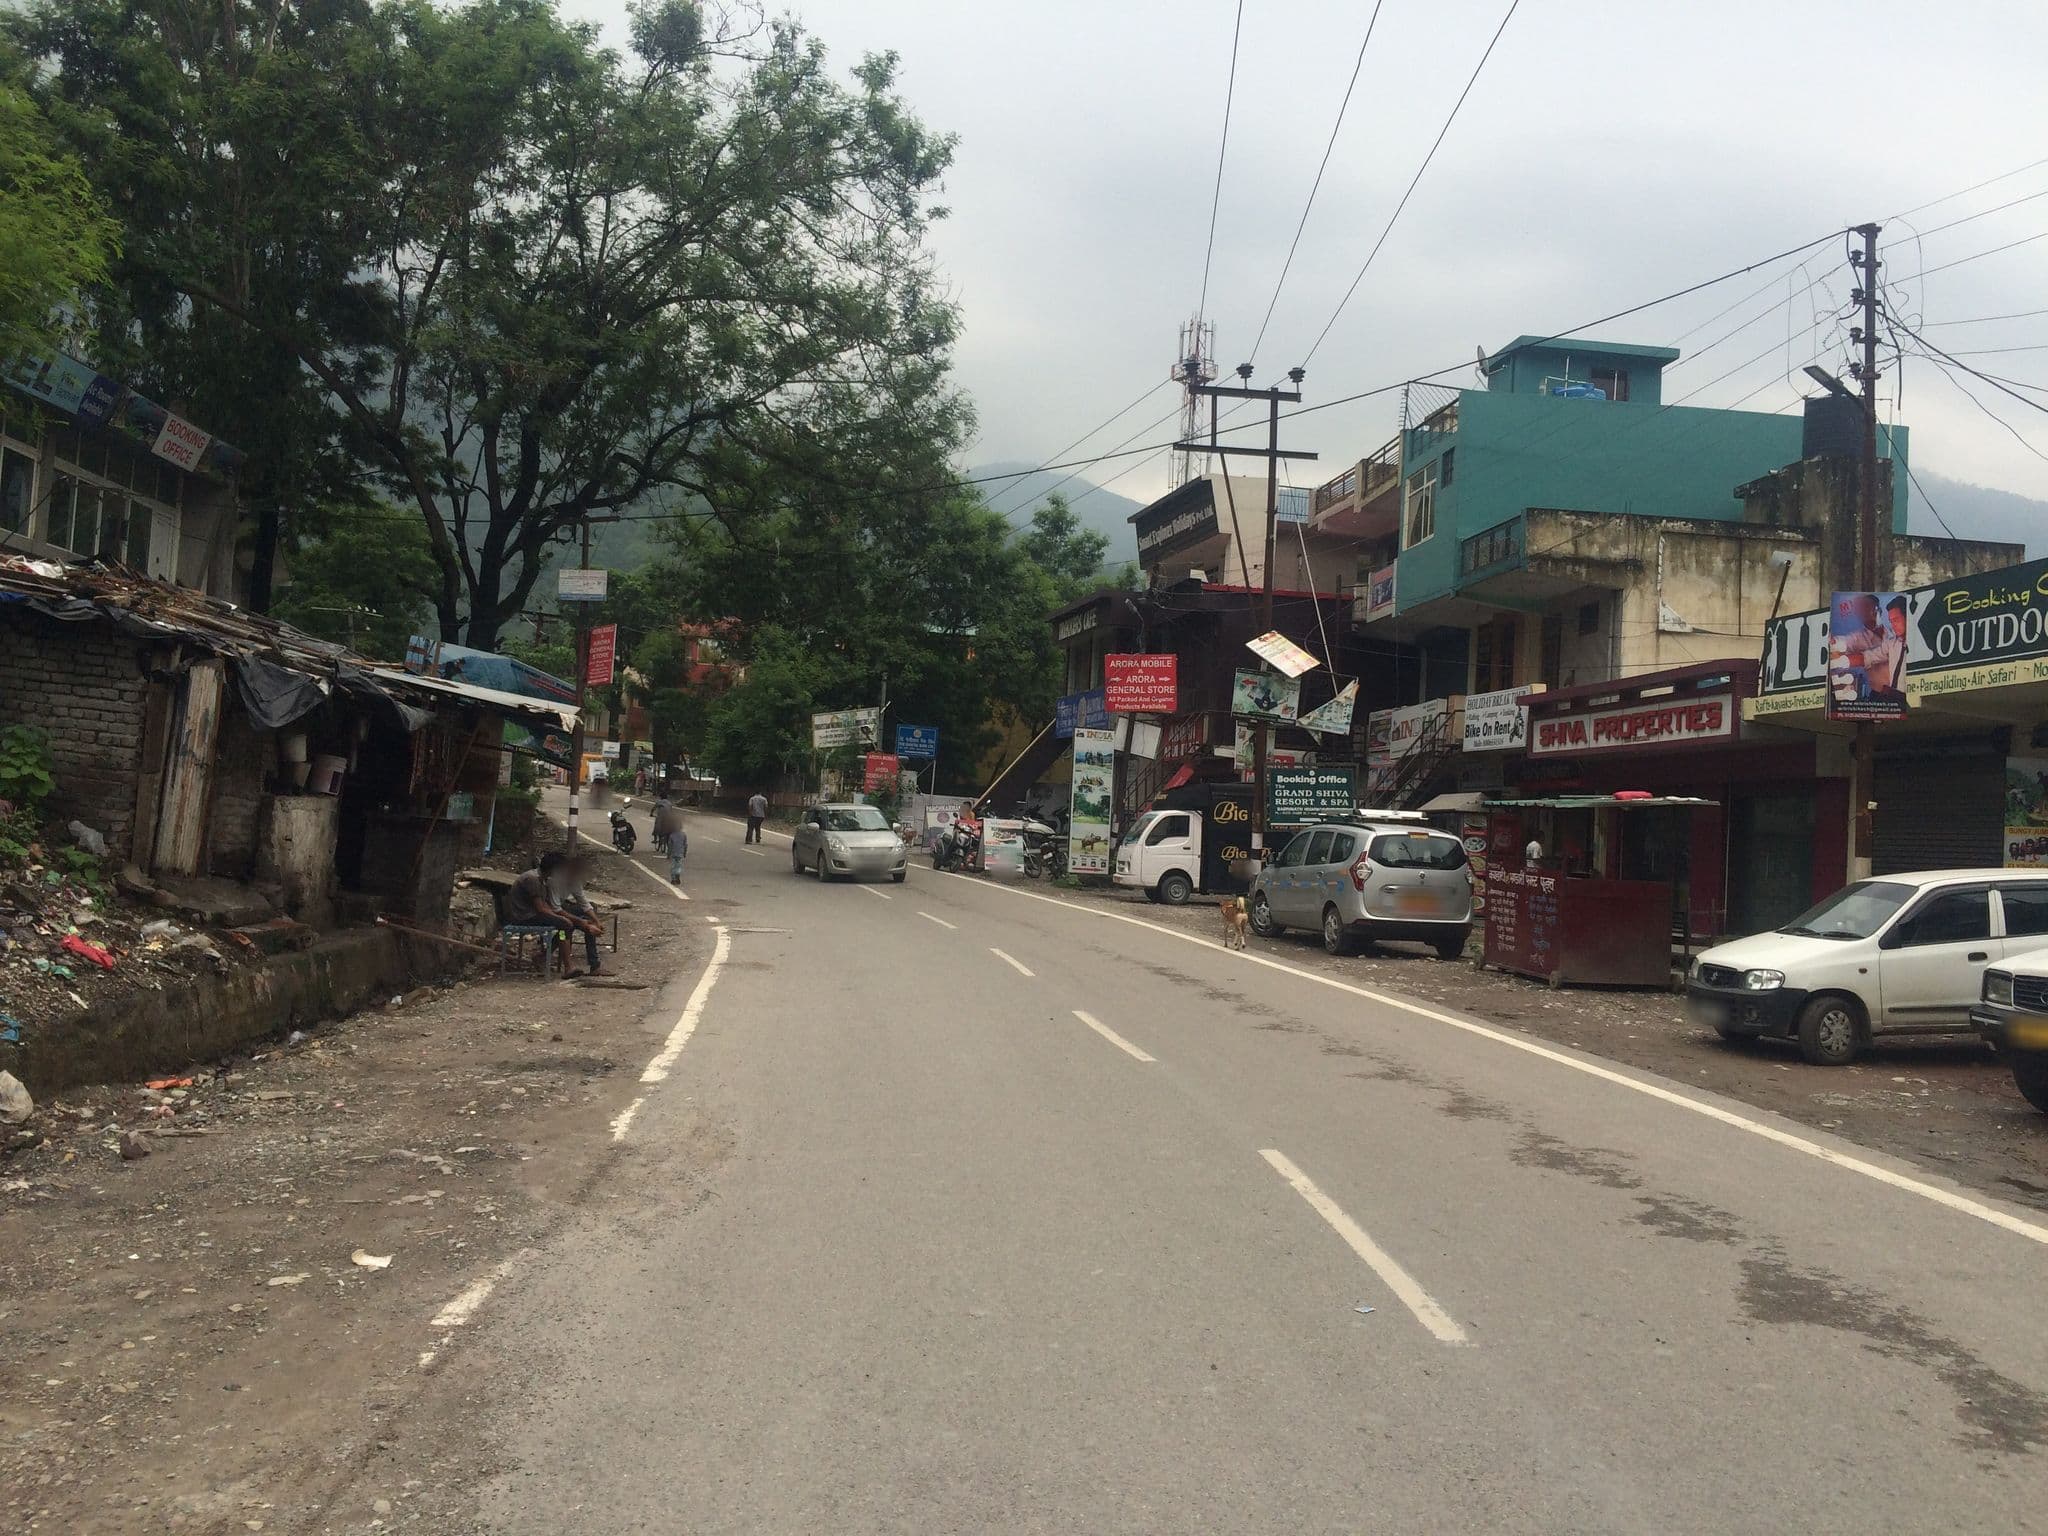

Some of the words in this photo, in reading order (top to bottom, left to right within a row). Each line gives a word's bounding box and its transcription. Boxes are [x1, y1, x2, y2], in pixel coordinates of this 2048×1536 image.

[167, 419, 206, 449] BOOKING
[162, 439, 193, 465] OFFICE
[1943, 588, 2031, 615] Booking
[1110, 660, 1139, 668] ARORA
[1141, 660, 1173, 668] MOBILE
[1126, 675, 1156, 684] ARORA
[1971, 671, 1986, 686] Air
[1988, 666, 2018, 685] Safari
[1106, 685, 1146, 694] GENERAL
[1147, 685, 1176, 694] STORE
[1465, 724, 1481, 738] Bike
[1482, 722, 1493, 737] On
[1494, 720, 1511, 735] Rent
[1540, 720, 1588, 748] SHIVA
[1593, 702, 1723, 742] PROPERTIES
[1277, 775, 1316, 785] Booking
[1318, 775, 1347, 783] Office
[1275, 789, 1313, 797] GRAND
[1316, 789, 1349, 798] SHIVA
[1275, 798, 1315, 806] RESORT
